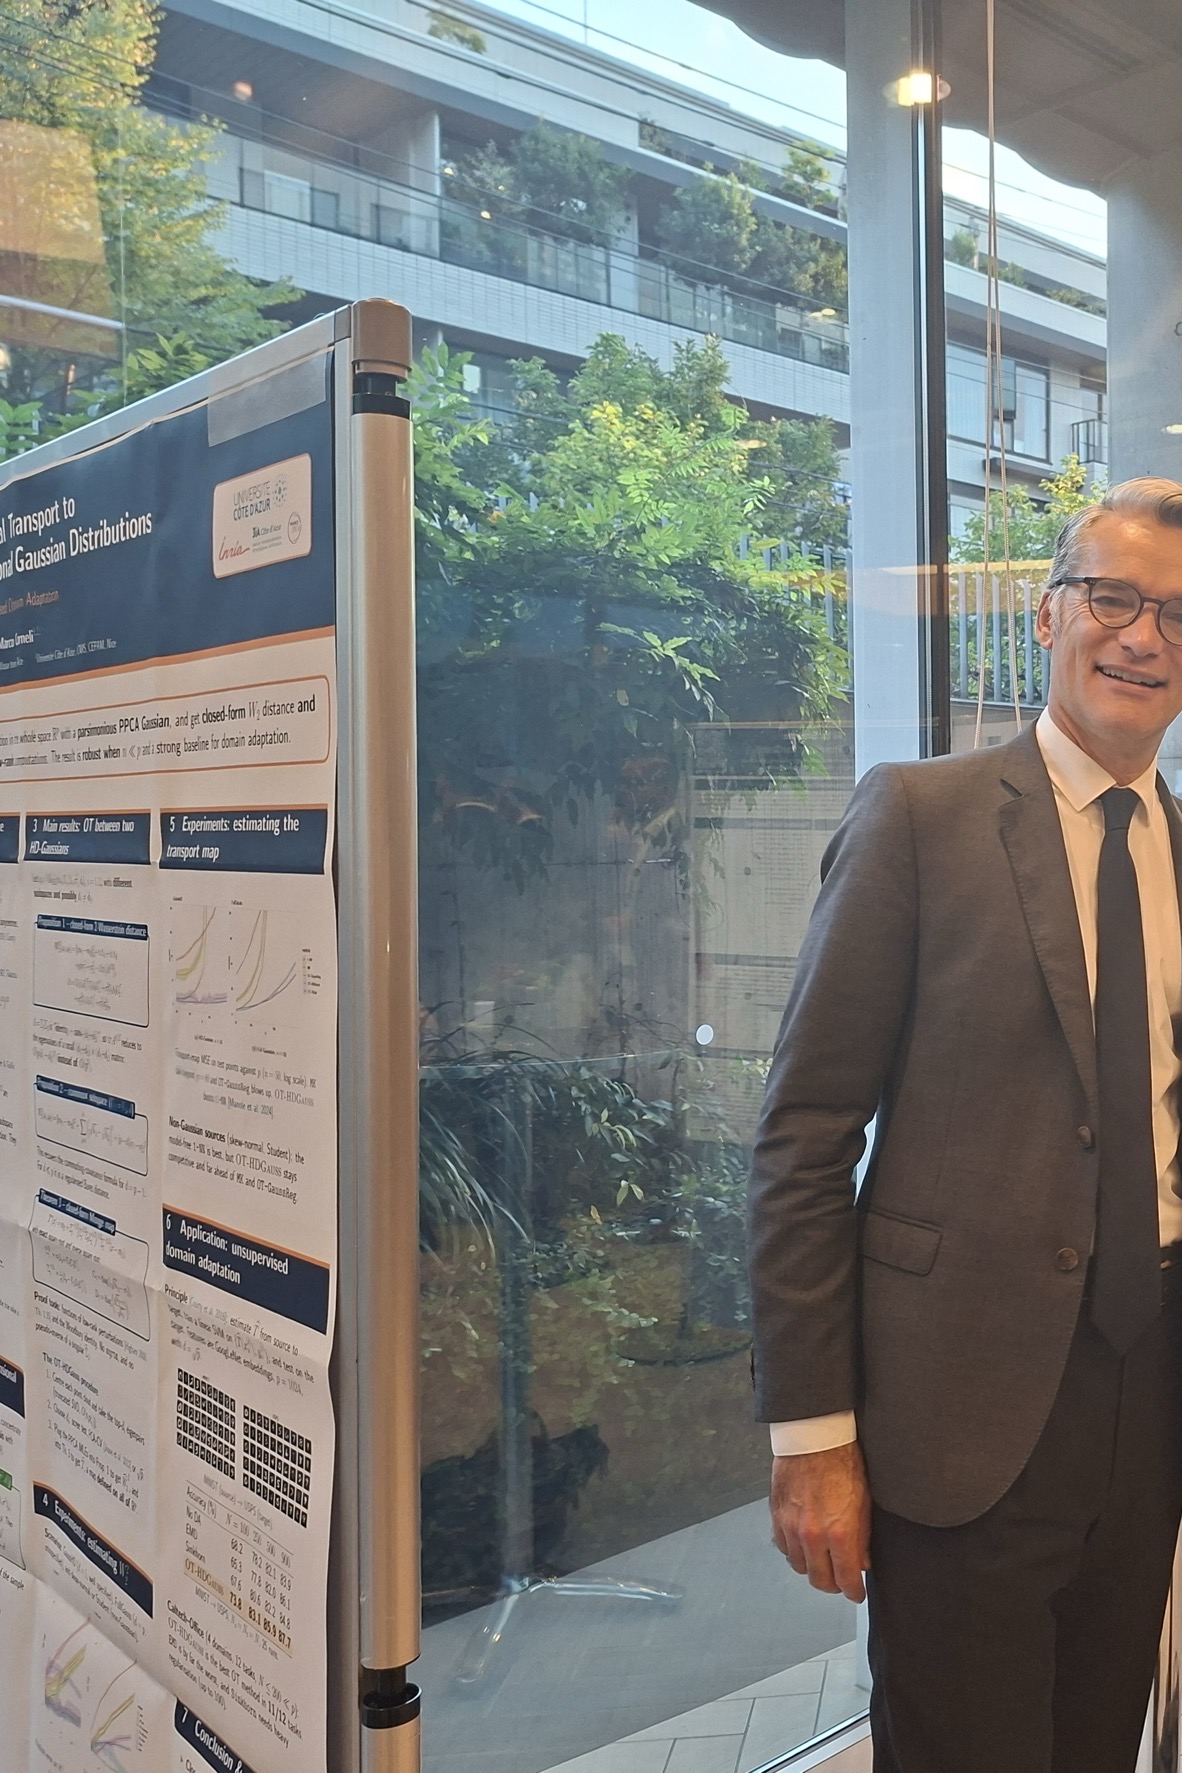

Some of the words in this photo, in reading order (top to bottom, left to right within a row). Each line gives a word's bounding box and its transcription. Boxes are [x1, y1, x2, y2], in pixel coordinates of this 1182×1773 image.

[8, 500, 59, 538] Transport
[63, 497, 75, 520] to
[15, 538, 66, 572] Gaussian
[69, 511, 152, 557] Distributions
[119, 718, 139, 734] PPCA
[141, 713, 172, 730] Gaussian,
[175, 711, 188, 727] and
[191, 713, 200, 729] get
[202, 705, 245, 723] closed-form
[262, 700, 294, 716] distance
[298, 695, 315, 712] and
[156, 741, 181, 756] strong
[183, 736, 209, 752] baseline
[211, 734, 219, 749] for
[222, 732, 245, 749] domain
[248, 728, 291, 749] adaptation.
[32, 819, 37, 832] 3
[42, 819, 58, 832] Main
[83, 819, 94, 832] OT
[95, 818, 120, 832] between
[122, 819, 134, 832] two
[170, 816, 175, 832] 5
[182, 816, 230, 835] Experiments:
[233, 816, 280, 836] estimating
[284, 815, 299, 832] the
[167, 844, 200, 861] transport
[202, 846, 219, 862] map
[169, 1116, 203, 1136] Non-Gaussian
[205, 1129, 225, 1143] sources
[166, 1214, 171, 1230] 6
[180, 1219, 228, 1251] Application:
[232, 1243, 288, 1275] unsupervised
[166, 1241, 195, 1265] domain
[199, 1255, 240, 1284] adaptation
[165, 1284, 188, 1304] Principle
[43, 1494, 48, 1506] 4
[230, 1591, 242, 1610] 73.8
[249, 1606, 261, 1626] 83.1
[263, 1617, 277, 1637] 85.9
[279, 1630, 291, 1649] 87.7
[181, 1707, 187, 1723] 7
[195, 1720, 234, 1770] Conclusion
